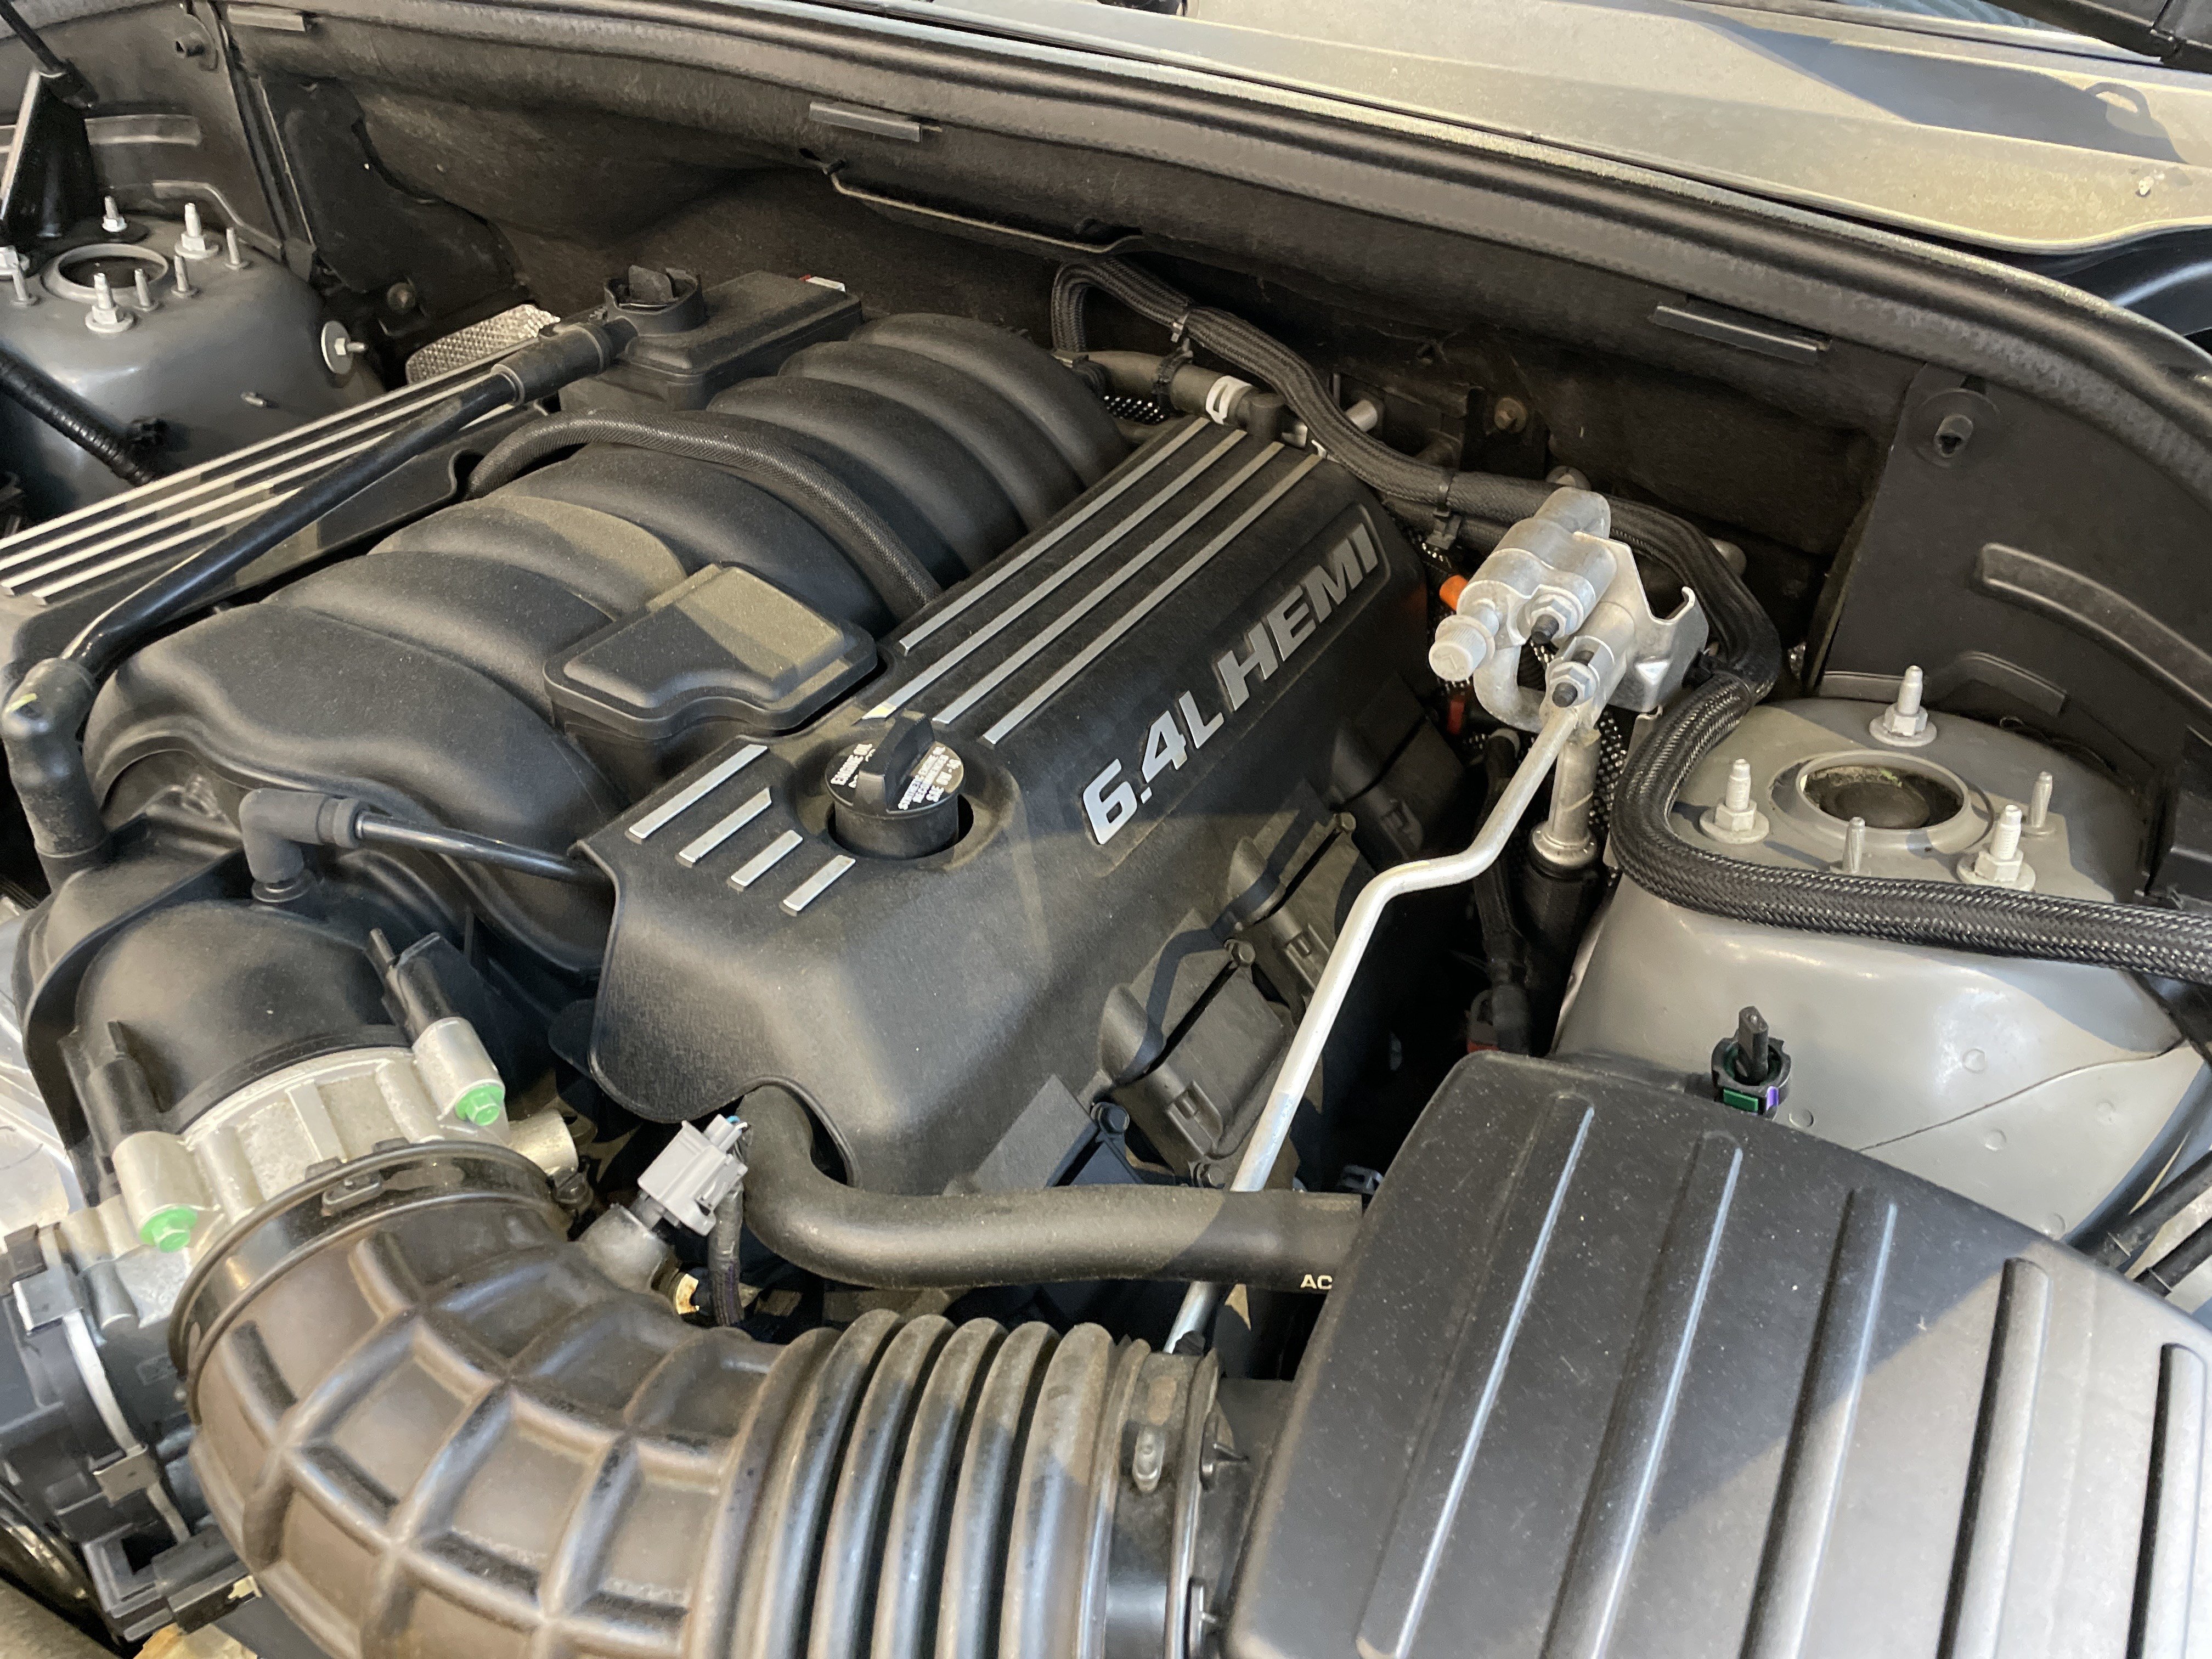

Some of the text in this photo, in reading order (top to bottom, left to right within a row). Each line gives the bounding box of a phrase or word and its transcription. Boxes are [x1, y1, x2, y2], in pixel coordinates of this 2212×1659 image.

[830, 743, 873, 786] ENGINE OIL
[926, 785, 945, 803] SAE
